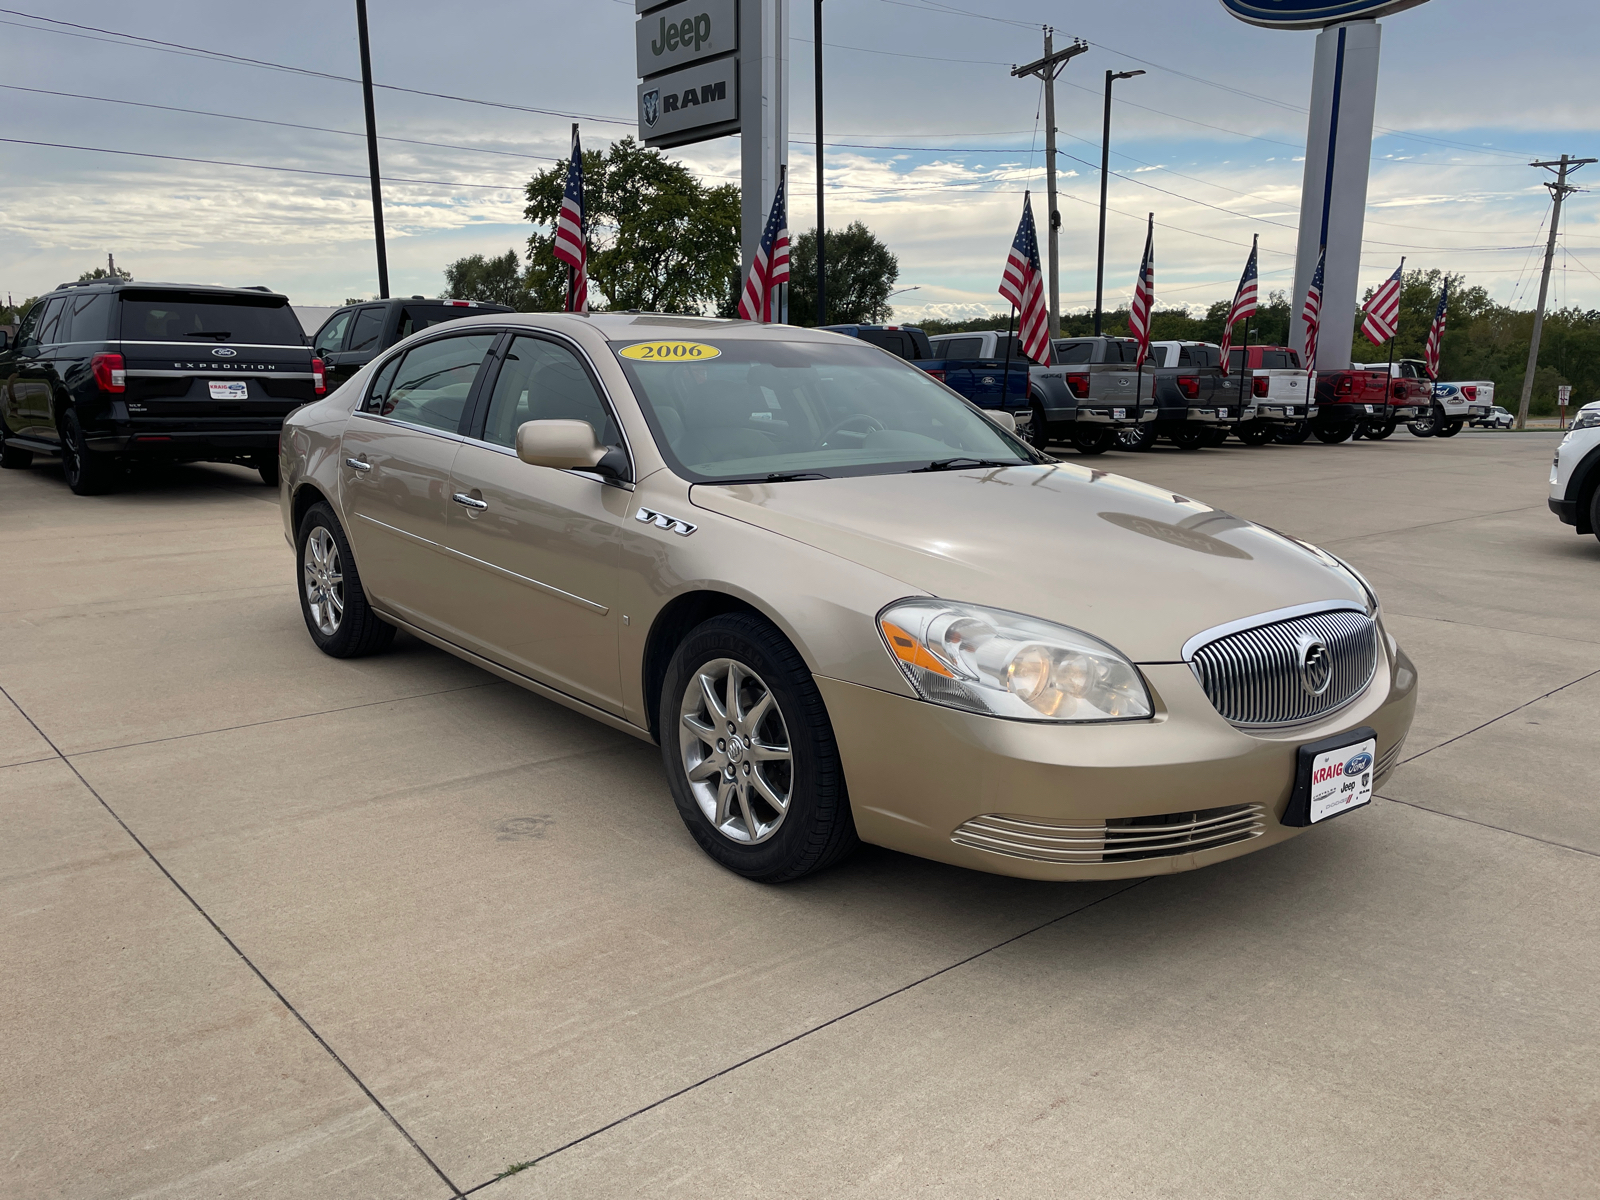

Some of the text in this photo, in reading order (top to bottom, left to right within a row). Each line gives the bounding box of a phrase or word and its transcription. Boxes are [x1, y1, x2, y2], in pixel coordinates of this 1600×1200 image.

[651, 12, 711, 56] Jeep
[663, 81, 726, 113] RAM
[640, 344, 702, 358] 2006
[174, 362, 275, 370] EXPEDITION
[1313, 762, 1344, 785] KRAIG
[1340, 781, 1356, 794] Jeep
